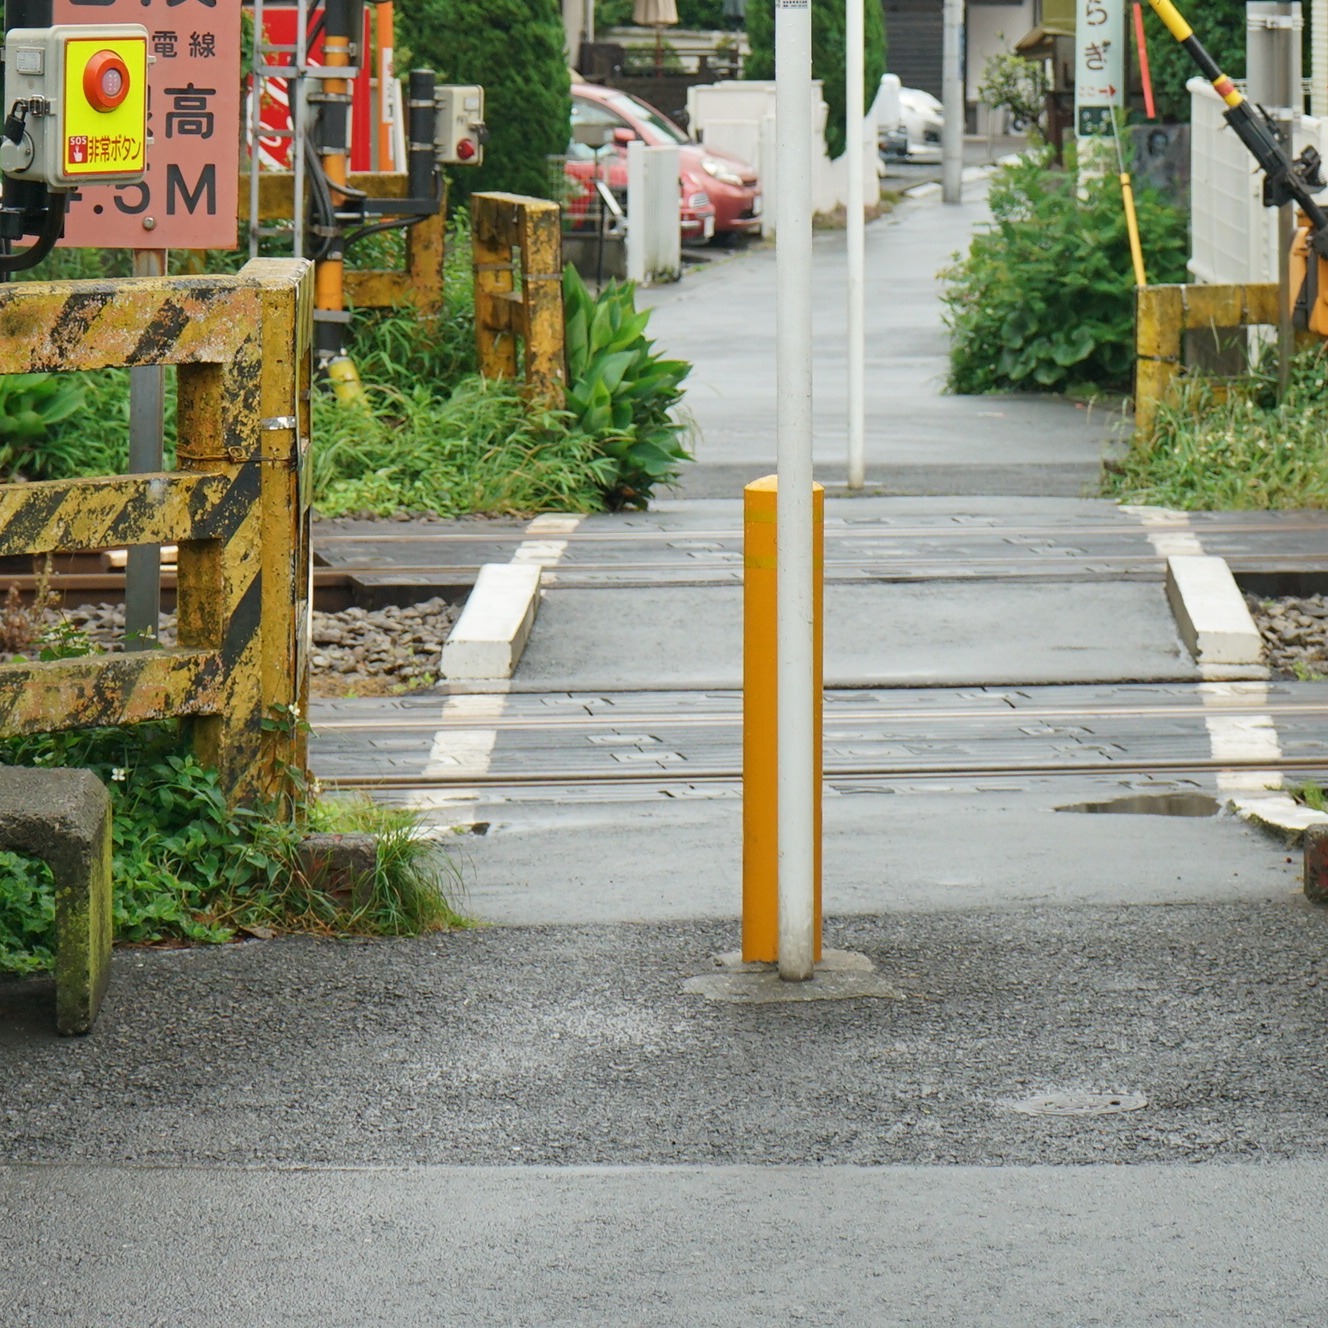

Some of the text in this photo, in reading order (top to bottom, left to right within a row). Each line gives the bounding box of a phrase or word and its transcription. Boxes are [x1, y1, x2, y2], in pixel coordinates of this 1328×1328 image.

[152, 31, 216, 59] 電線
[146, 83, 216, 139] 高
[70, 136, 87, 145] SOS
[88, 135, 142, 163] 非常ボタン
[64, 163, 216, 215] .5M
